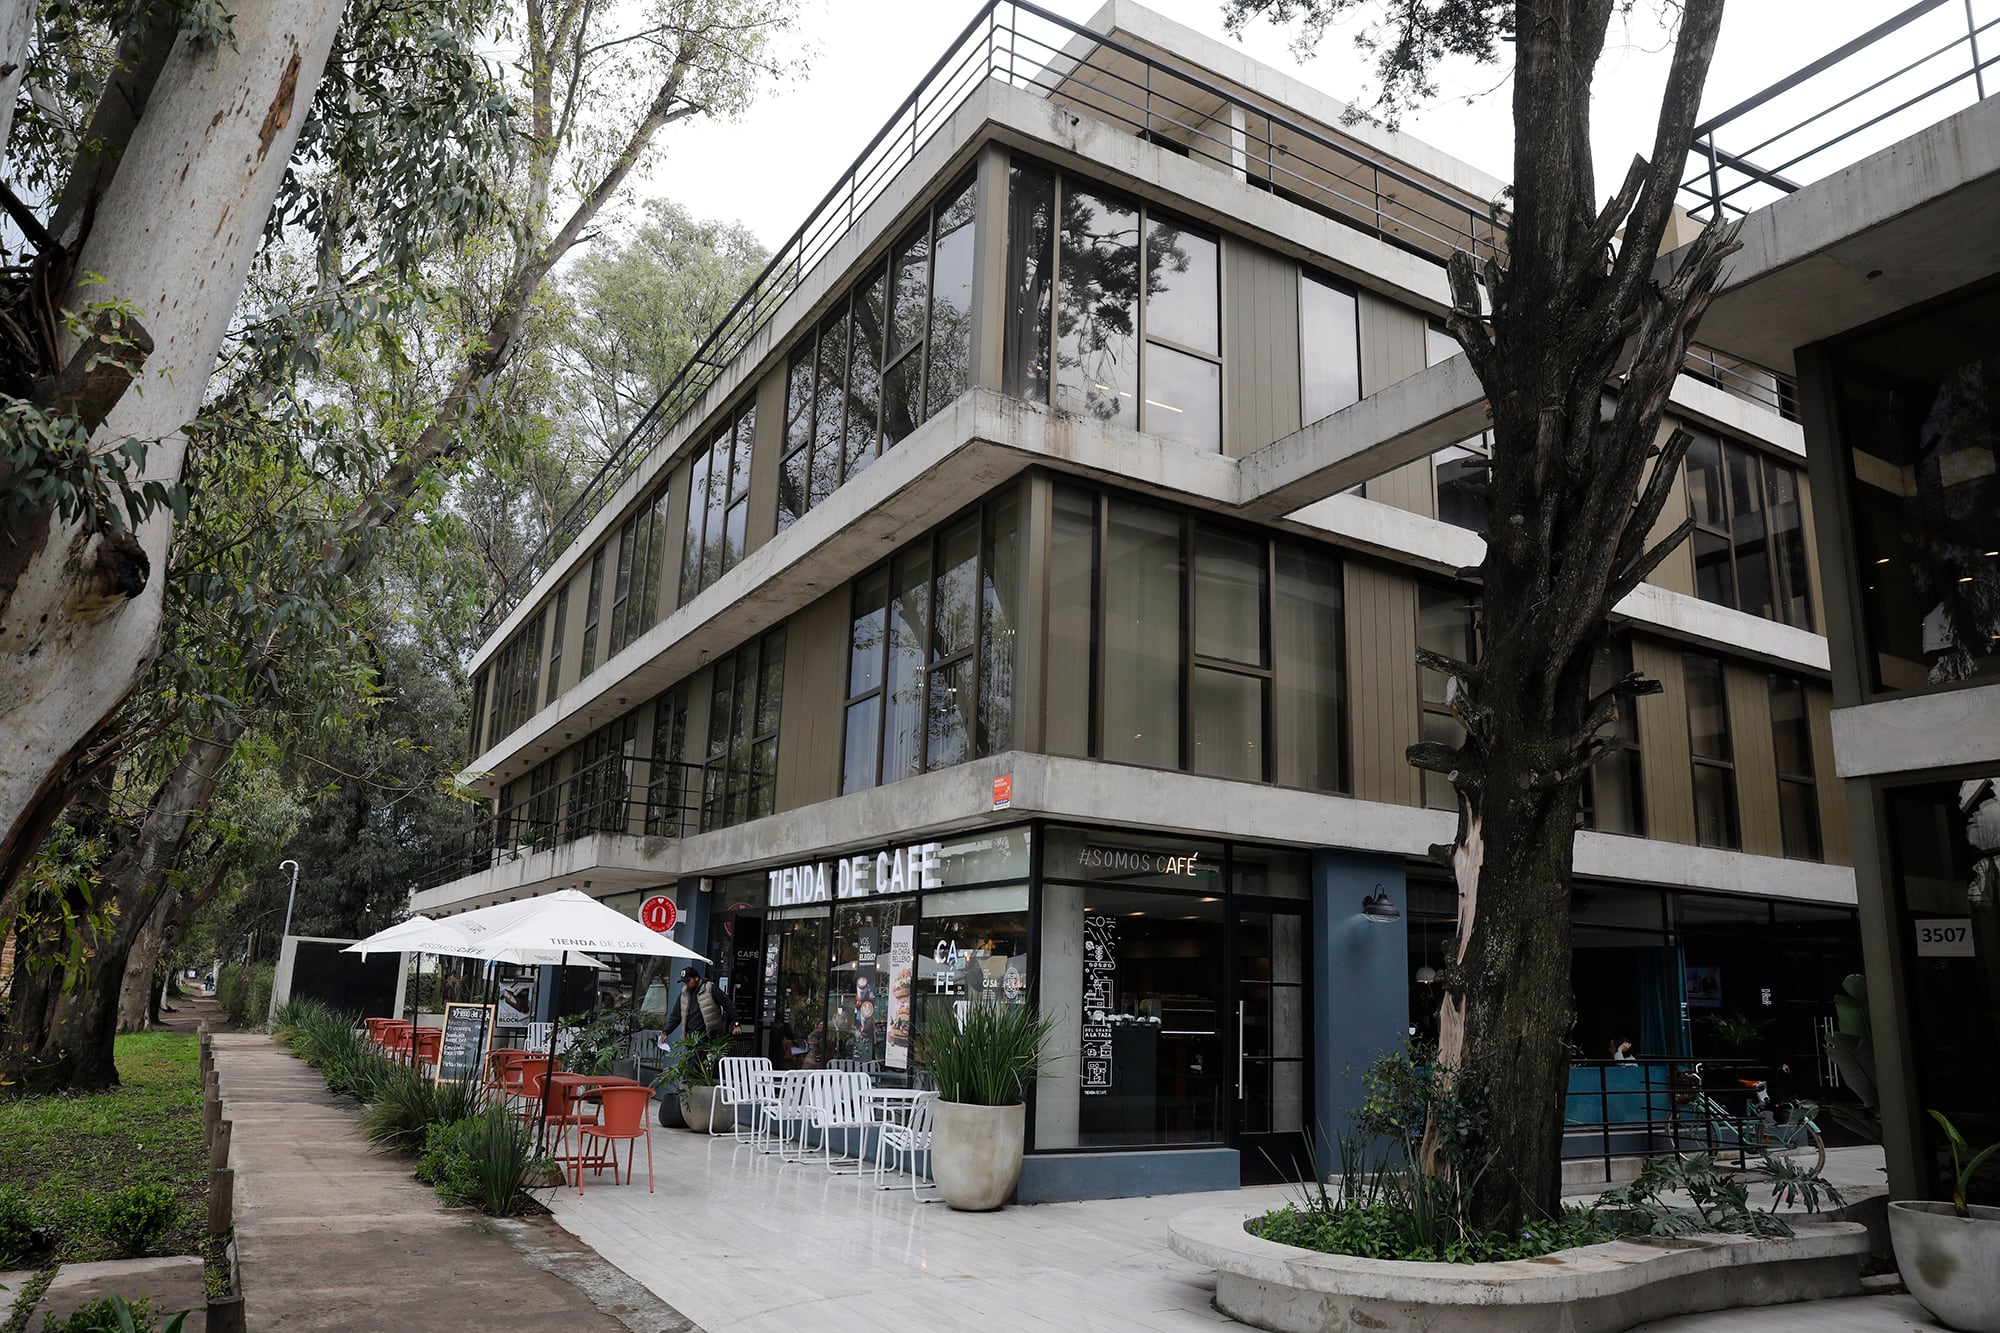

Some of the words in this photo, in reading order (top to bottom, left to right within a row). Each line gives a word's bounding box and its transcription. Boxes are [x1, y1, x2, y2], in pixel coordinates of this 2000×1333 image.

[1078, 849, 1151, 871] #SOMOS
[1157, 852, 1199, 876] CAFÉ
[769, 862, 832, 907] TIENDA
[838, 856, 869, 899] DE
[876, 842, 942, 894] CAFE
[549, 938, 597, 947] TIENDA
[599, 940, 615, 948] DE
[1921, 927, 1967, 943] 3507
[737, 950, 759, 959] CAFÉ
[936, 939, 958, 964] CA
